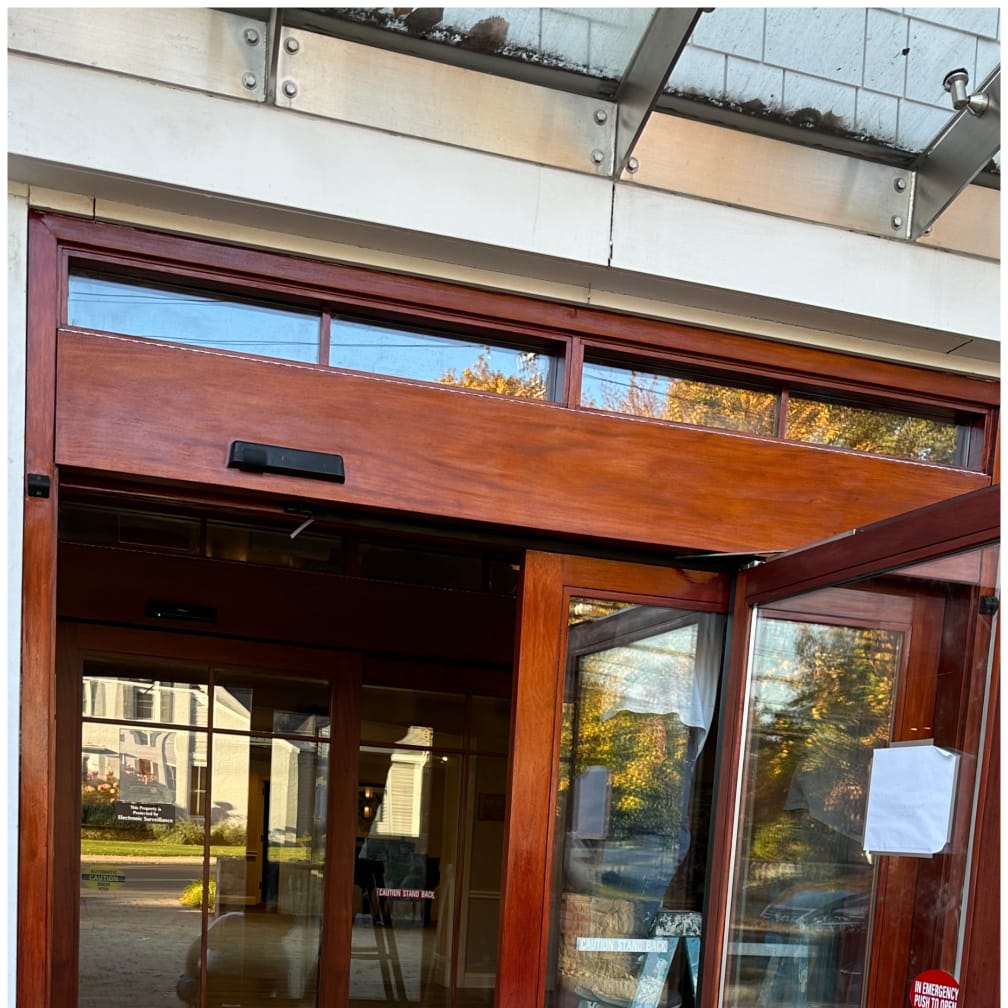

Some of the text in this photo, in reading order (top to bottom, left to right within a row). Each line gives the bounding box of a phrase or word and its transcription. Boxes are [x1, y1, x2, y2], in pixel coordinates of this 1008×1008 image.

[379, 888, 435, 899] CAUTION STAND BACK
[646, 941, 668, 952] BACK
[914, 980, 959, 1001] IN EMERGENCY
[914, 994, 930, 1008] PUSH
